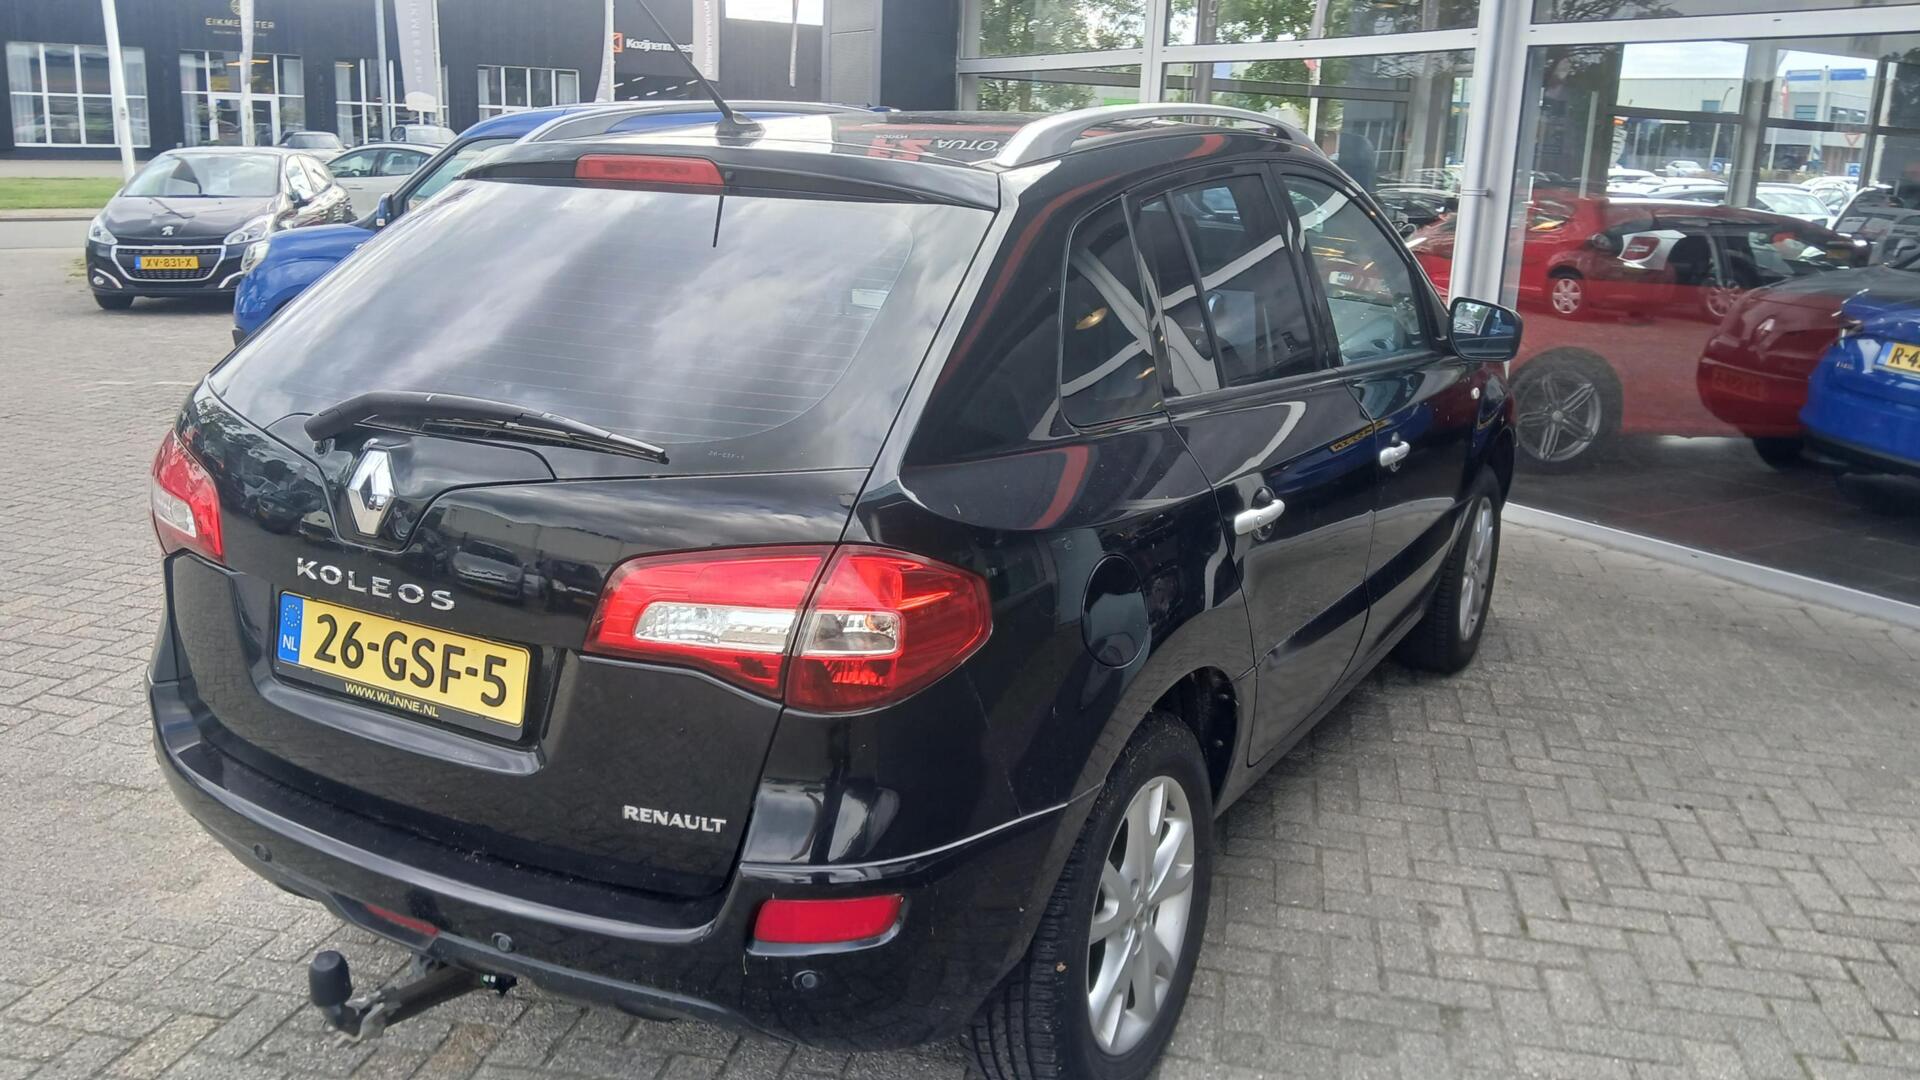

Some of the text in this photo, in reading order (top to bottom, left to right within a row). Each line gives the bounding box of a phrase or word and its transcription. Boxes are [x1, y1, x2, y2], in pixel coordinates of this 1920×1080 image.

[1890, 346, 1920, 368] R-4
[296, 557, 455, 611] KOLEOS
[282, 613, 508, 708] NL 26-GSF-5
[344, 682, 440, 718] WWW.WIJNNE.NL
[622, 804, 727, 833] RENAULT
